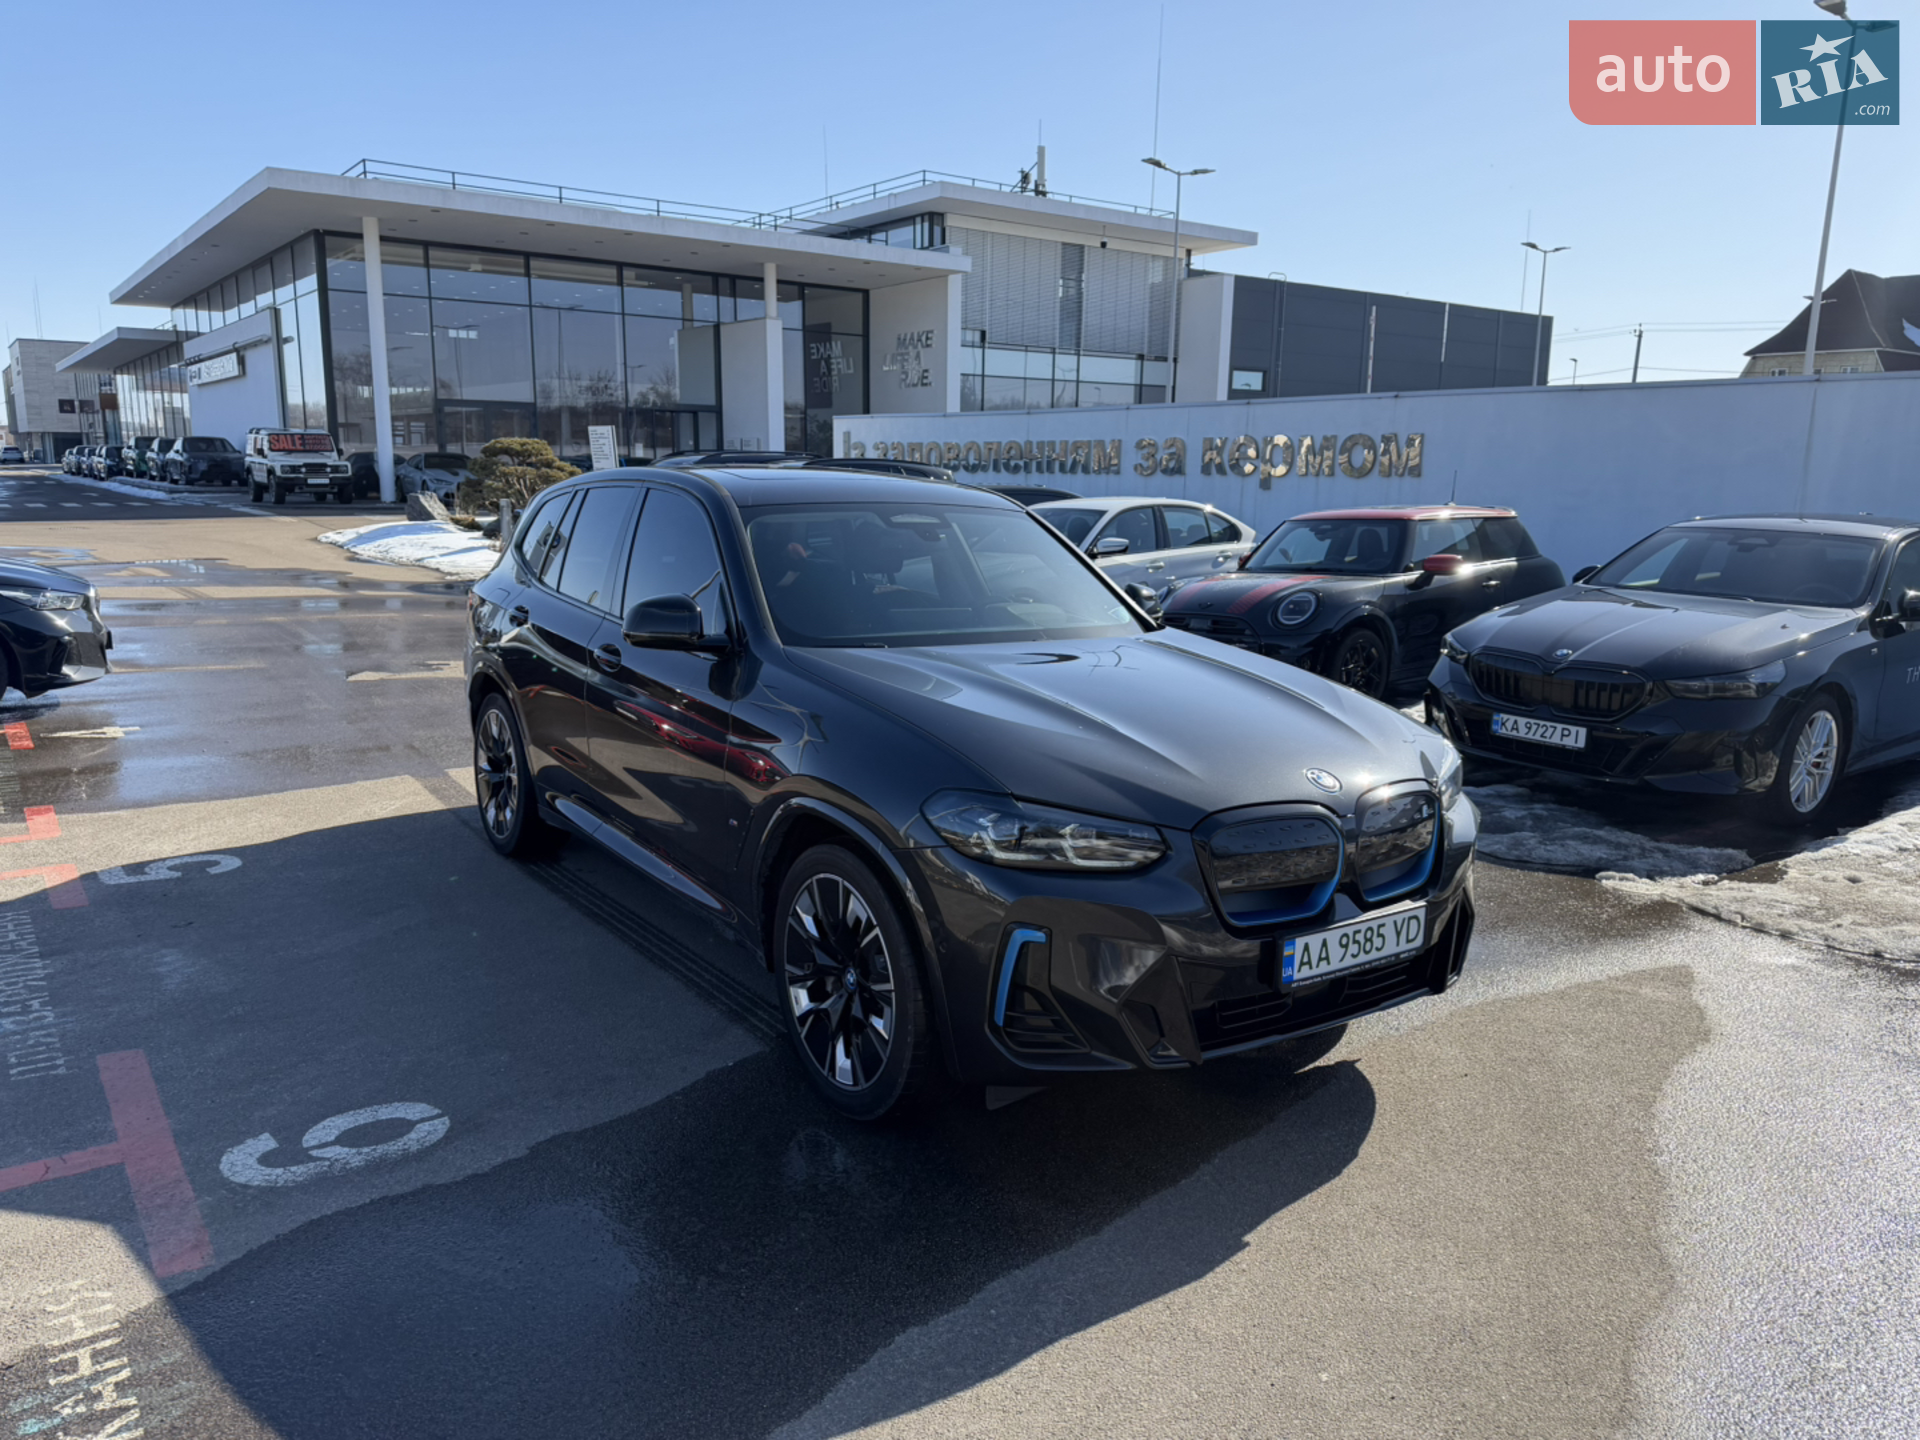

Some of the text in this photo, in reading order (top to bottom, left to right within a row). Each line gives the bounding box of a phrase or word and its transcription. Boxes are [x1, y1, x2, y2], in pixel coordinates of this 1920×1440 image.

[896, 329, 936, 350] MAKE
[269, 434, 304, 451] SALE
[1133, 437, 1187, 476] за
[1200, 431, 1425, 491] кермом
[1500, 716, 1520, 734] KA
[1524, 721, 1558, 740] 9727
[1297, 938, 1331, 973] AA
[1338, 923, 1386, 963] 9585
[1393, 914, 1422, 947] YD
[1282, 967, 1293, 977] UA
